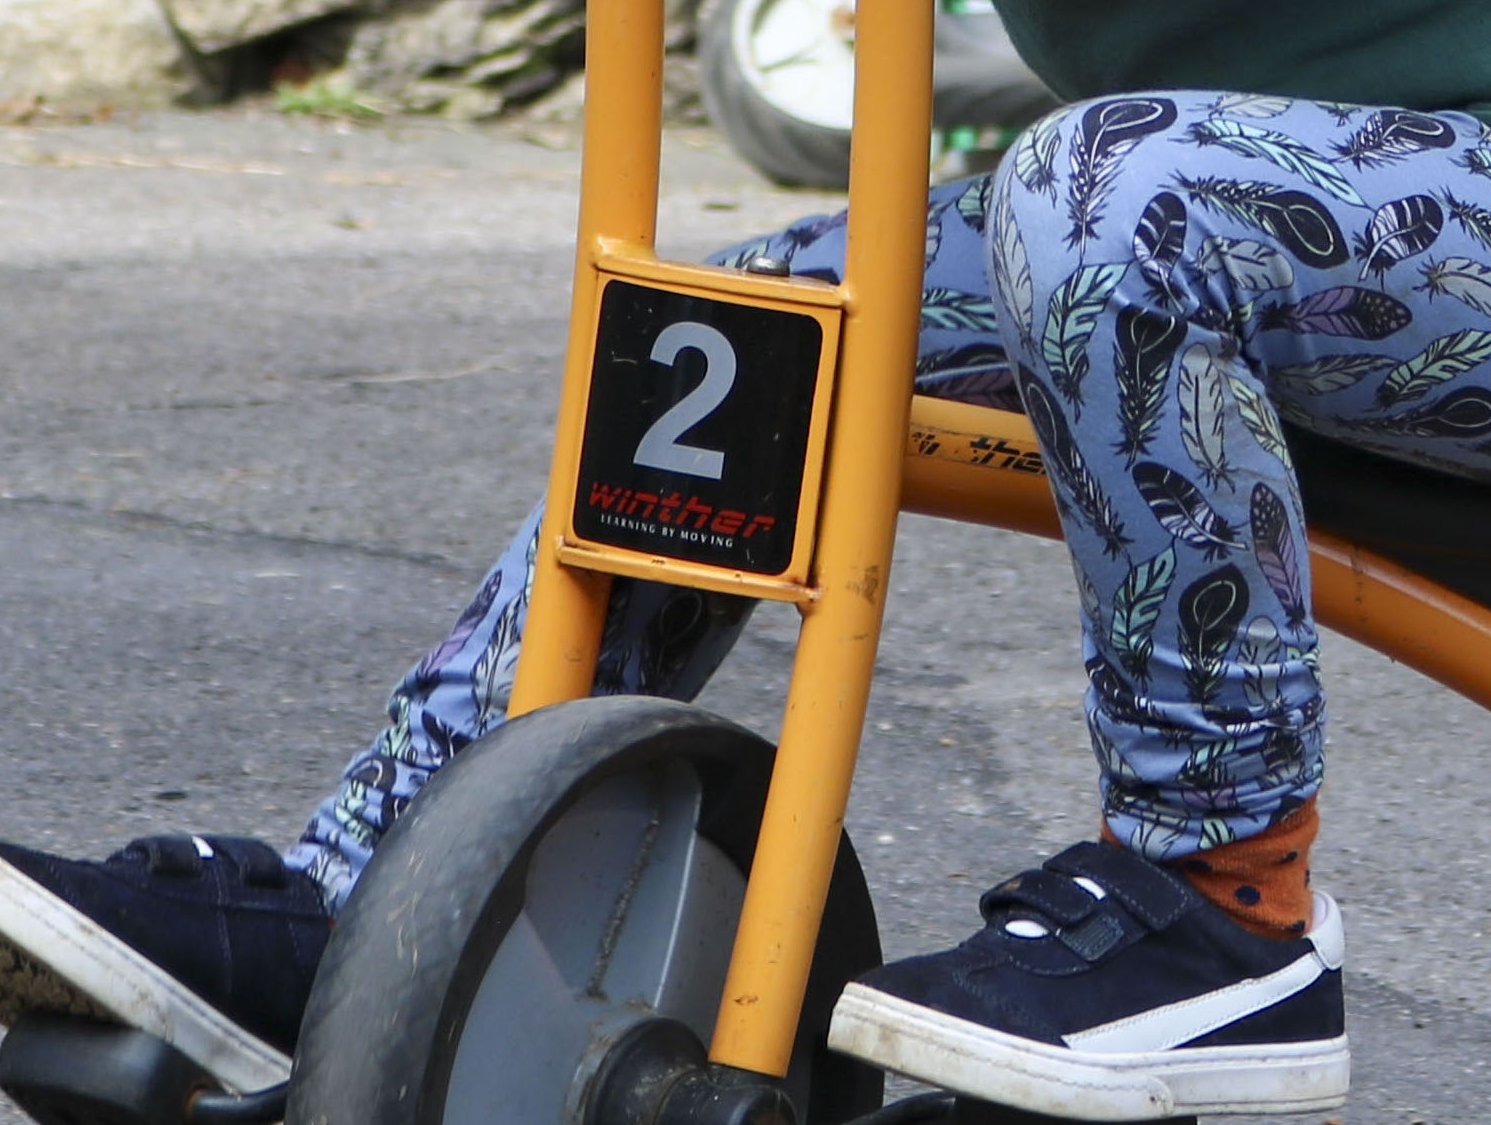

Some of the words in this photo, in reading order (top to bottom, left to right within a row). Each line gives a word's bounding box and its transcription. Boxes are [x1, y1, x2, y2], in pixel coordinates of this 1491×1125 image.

[633, 321, 737, 480] 2
[589, 482, 775, 538] winther
[600, 514, 656, 534] LEARNING
[661, 526, 675, 538] BY
[680, 530, 734, 549] MOVING
